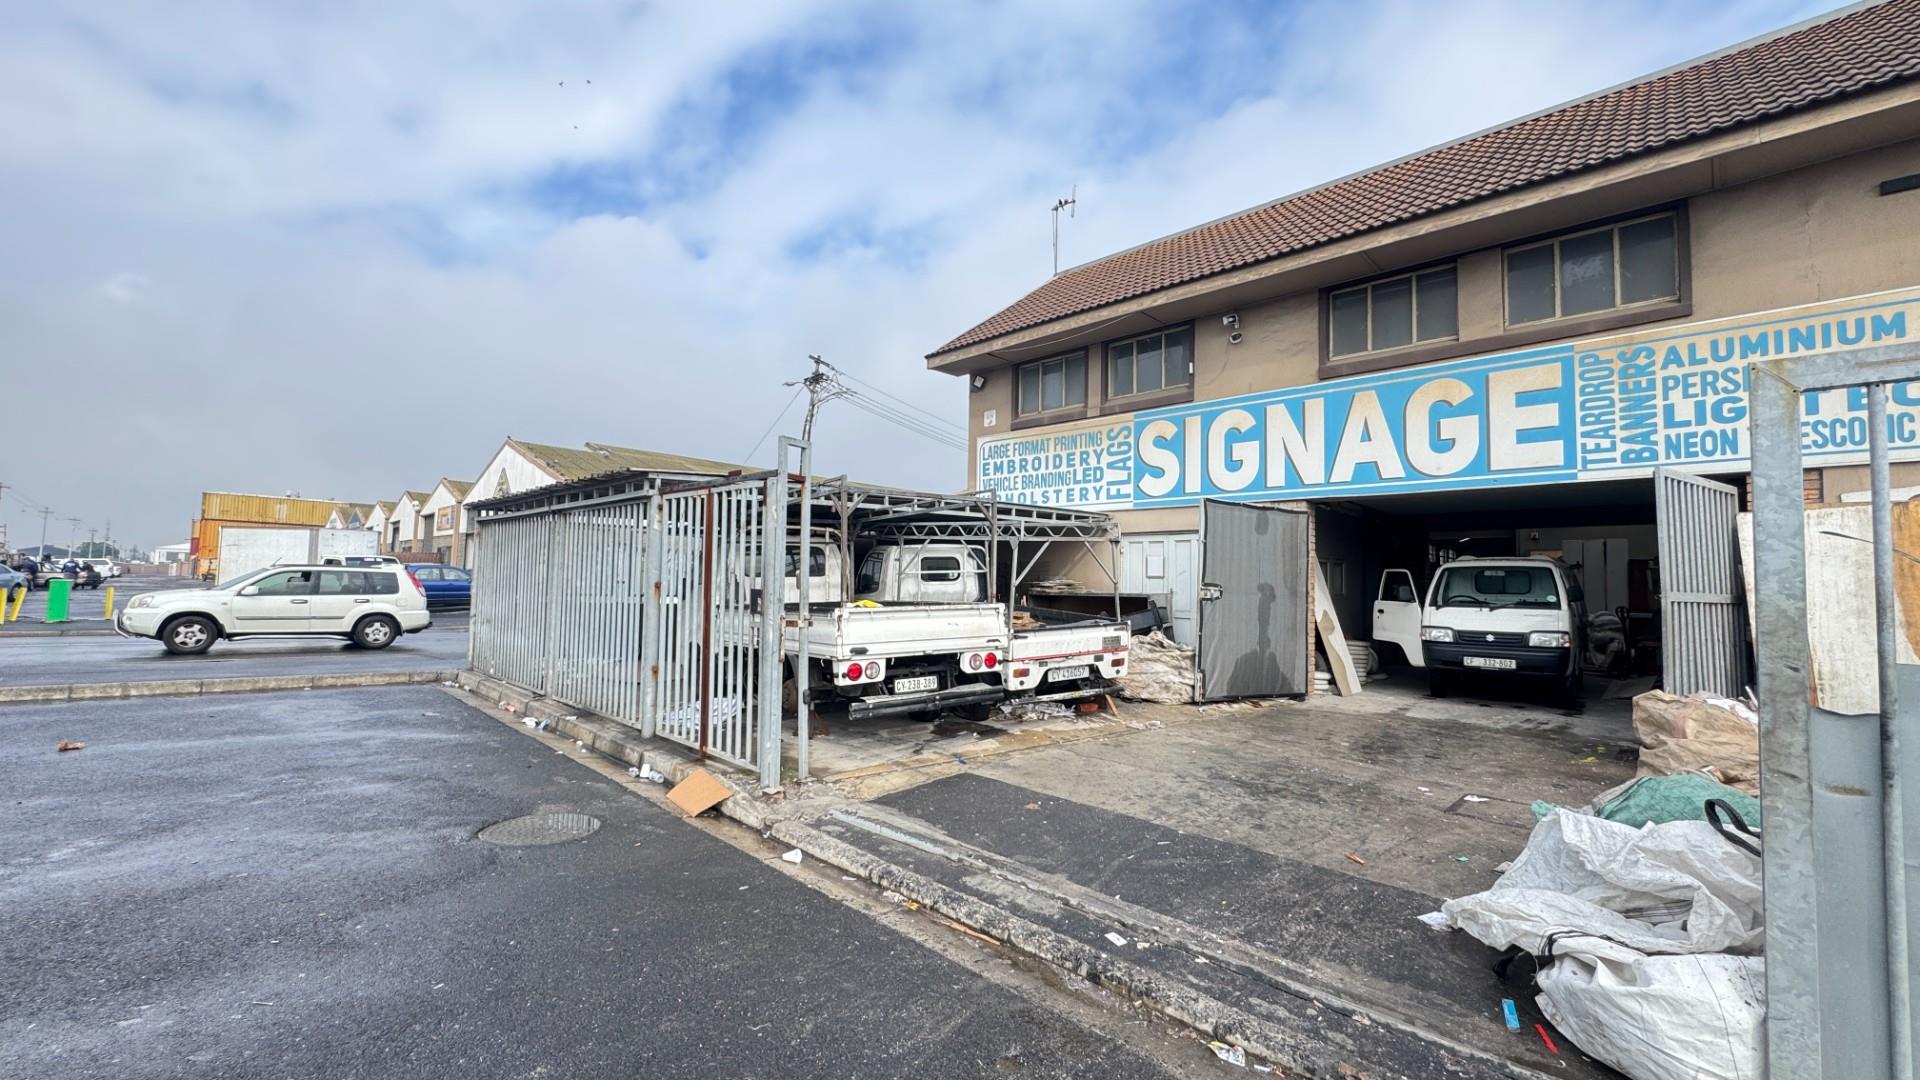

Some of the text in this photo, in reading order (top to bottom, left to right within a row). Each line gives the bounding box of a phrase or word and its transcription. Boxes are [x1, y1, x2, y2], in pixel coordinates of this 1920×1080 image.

[1660, 311, 1907, 371] ALUMINIUM
[1578, 352, 1618, 469] TEARDROP
[1617, 345, 1659, 464] BANNERS
[983, 431, 1103, 461] LARGE FORMAT PRINTING
[1137, 362, 1565, 497] SIGNAGE
[1664, 428, 1739, 460] NEON
[983, 447, 1106, 477] EMBROIDERY
[983, 465, 1105, 491] VEHICLE BRANDING LED
[1106, 425, 1132, 500] FLAGS
[983, 486, 1104, 505] HOLSTERY
